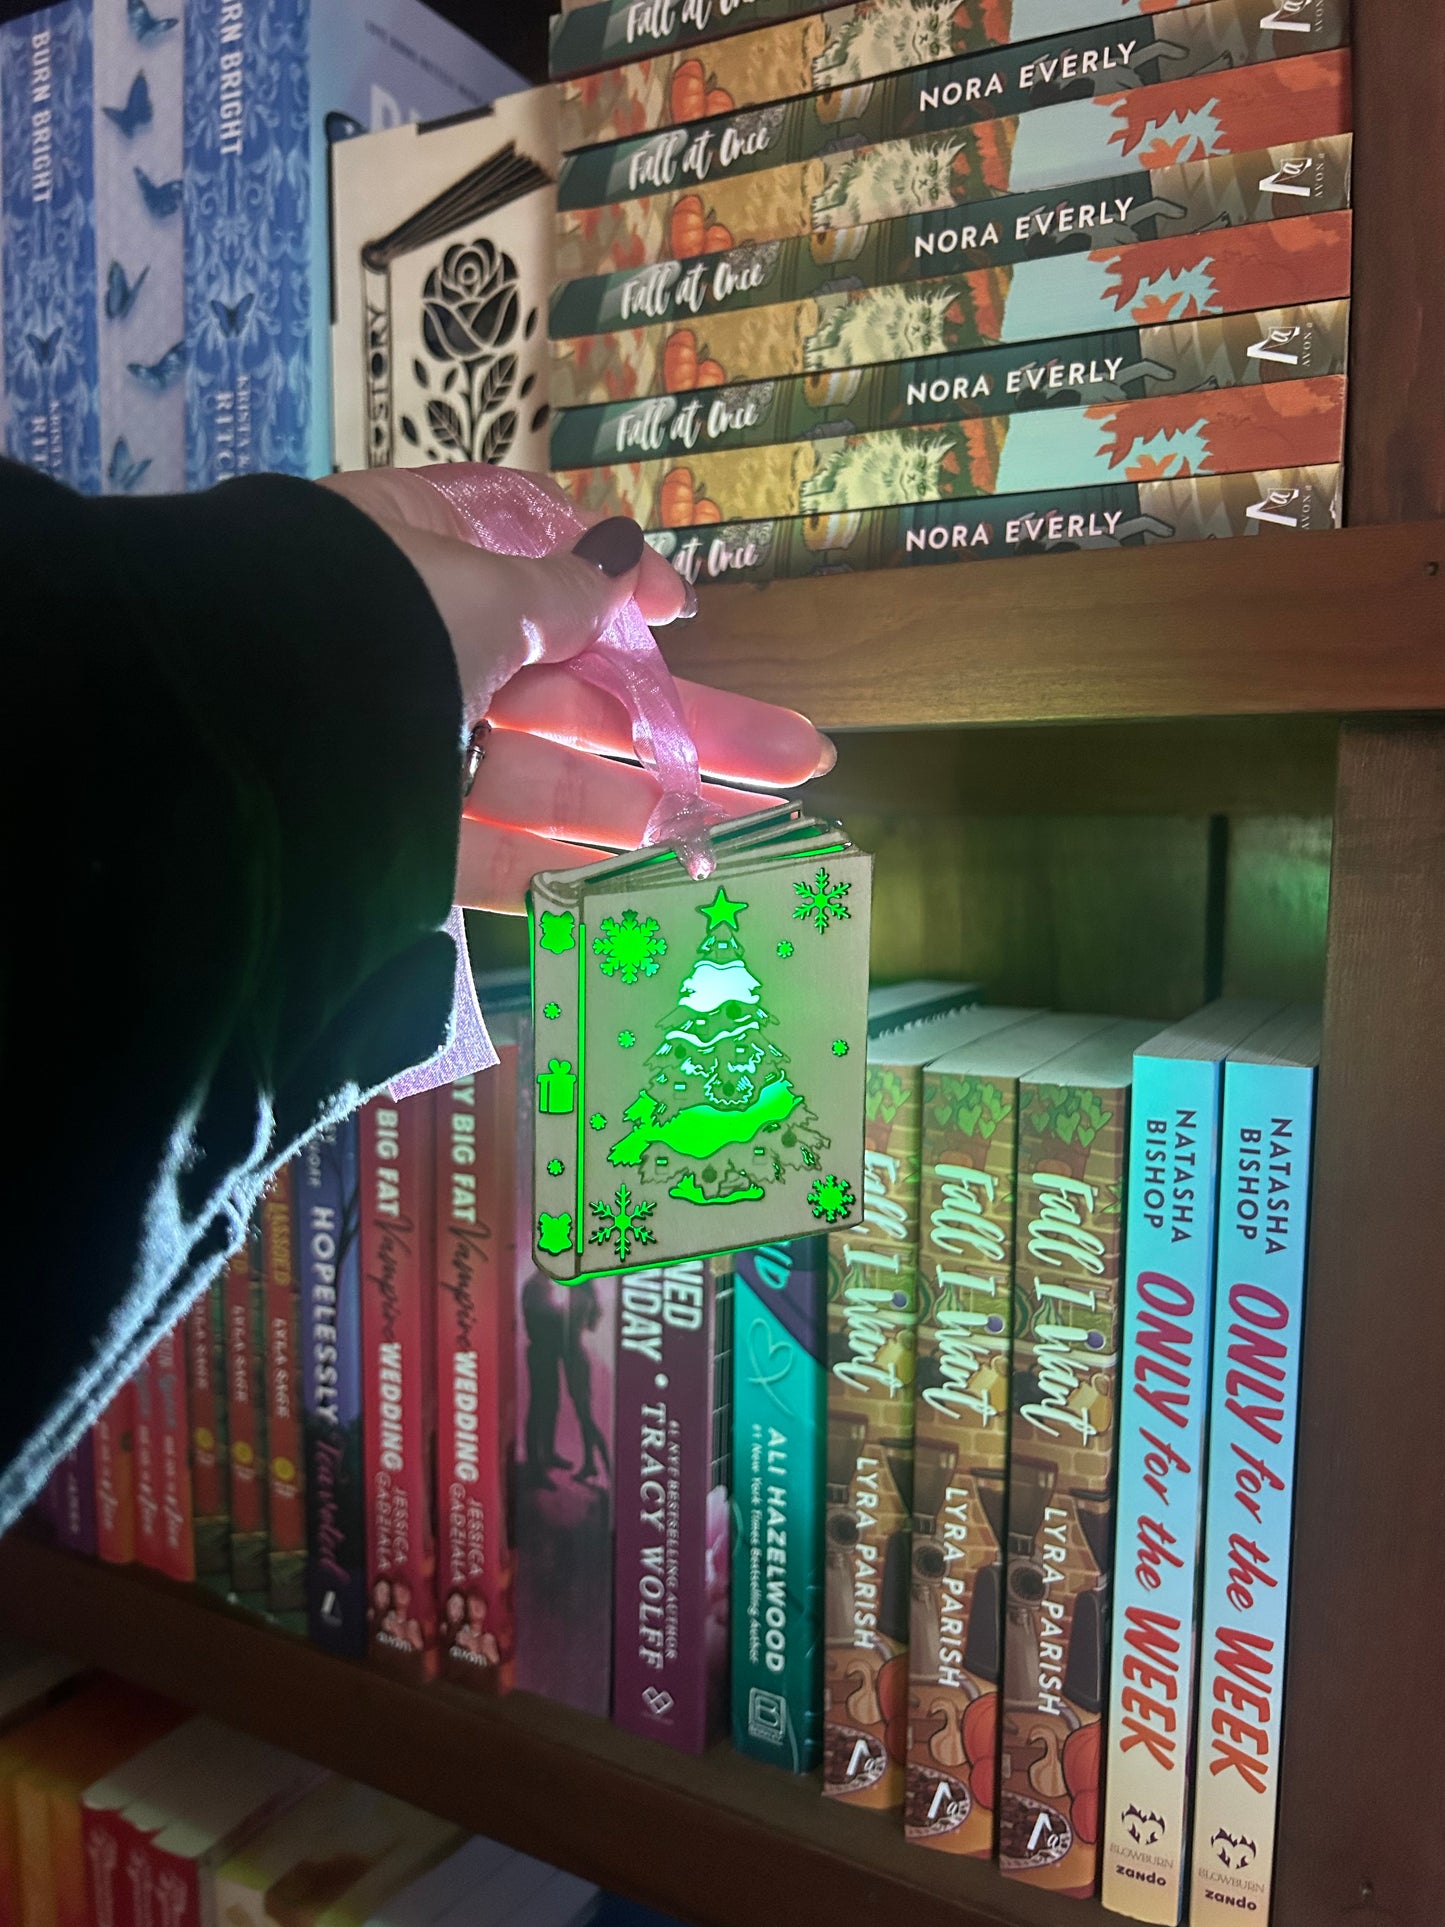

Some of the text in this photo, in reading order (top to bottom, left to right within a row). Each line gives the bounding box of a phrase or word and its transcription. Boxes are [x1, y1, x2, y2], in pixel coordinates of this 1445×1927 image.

[30, 31, 53, 203] BURN BRIGHT
[220, 0, 243, 156] RN BRIGHT
[918, 40, 1137, 112] NORA EVERLY
[629, 127, 770, 191] Fall at Once
[914, 196, 1135, 259] NORA EVERLY
[620, 262, 766, 320] Fall at Once
[214, 390, 235, 481] RITC
[615, 398, 761, 453] Fall at Once
[906, 357, 1124, 406] NORA EVERLY
[707, 536, 760, 577] Once
[905, 511, 1124, 553] NORA EVERLY
[375, 1107, 400, 1218] BIG FAT
[452, 1113, 475, 1166] BIG
[452, 1172, 476, 1224] FAT
[1143, 1119, 1168, 1230] BISHOP
[1170, 1108, 1198, 1244] NATASHA
[1235, 1127, 1262, 1242] BISHOP
[1264, 1117, 1293, 1256] NATASHA
[310, 1205, 339, 1426] HOPELESSLY
[367, 1216, 415, 1342] Vampire
[441, 1221, 491, 1350] Vampire
[843, 1243, 901, 1274] I
[922, 1163, 1005, 1427] Fall I Want
[1019, 1172, 1105, 1447] Fall I Want
[832, 1287, 903, 1398] Want
[379, 1342, 403, 1472] WEDDING
[454, 1350, 479, 1484] WEDDING
[393, 1485, 409, 1564] JESSICA
[469, 1497, 485, 1577] JESSICA
[637, 1402, 667, 1670] TRACY WOLFF
[763, 1426, 788, 1673] ALI HAZELWOOD
[853, 1455, 880, 1650] LYRA PARISH
[1118, 1270, 1196, 1772] ONLY for the WEEK
[1208, 1282, 1290, 1796] ONLY for the WEEK
[938, 1486, 969, 1688] LYRA PARISH
[1037, 1505, 1068, 1717] LYRA PARISH
